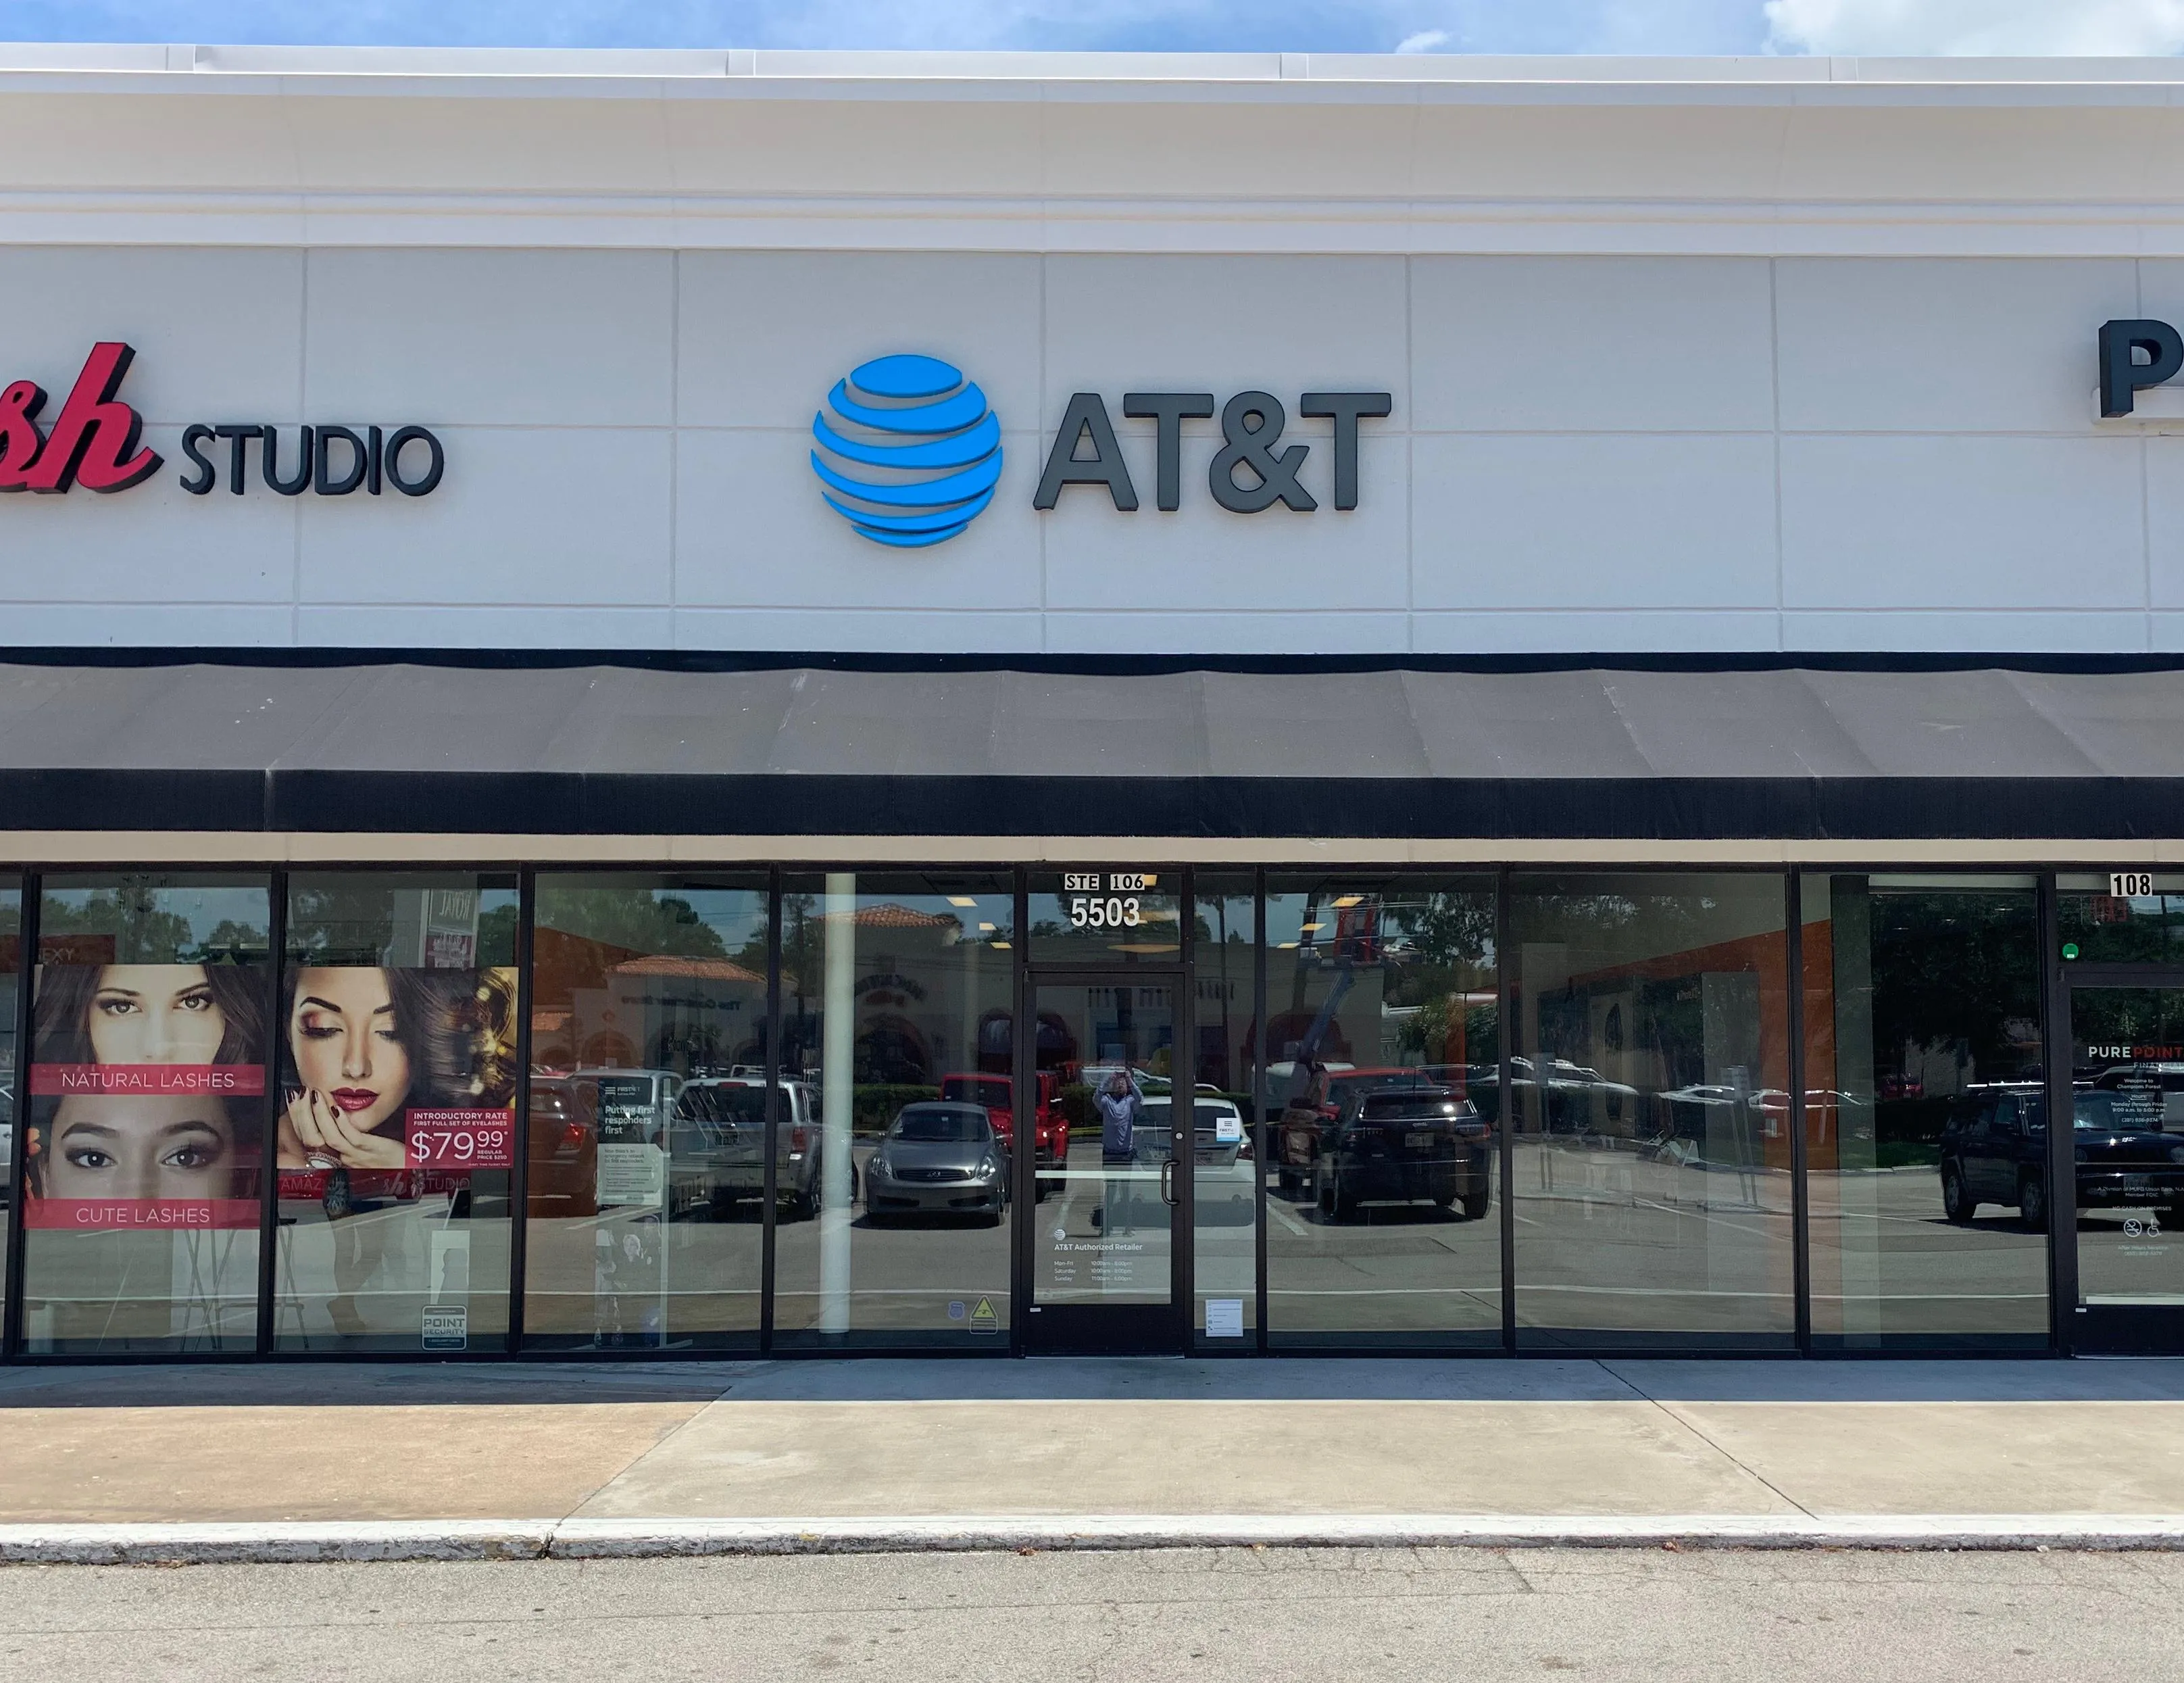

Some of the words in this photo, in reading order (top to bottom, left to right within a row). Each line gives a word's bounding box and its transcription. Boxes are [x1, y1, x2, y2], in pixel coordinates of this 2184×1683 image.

[1033, 391, 1391, 513] AT&T
[180, 424, 443, 496] STUDIO
[1066, 875, 1098, 889] STE
[1113, 875, 1143, 889] 106
[2114, 874, 2150, 896] 108
[1071, 897, 1139, 927] 5503
[62, 1073, 153, 1088] NATURAL
[160, 1073, 234, 1088] LASHES
[414, 1112, 482, 1120] INTRODUCTORY
[485, 1112, 507, 1120] RATE
[605, 1106, 636, 1115] Putting
[637, 1106, 655, 1115] first
[605, 1115, 652, 1125] responders
[605, 1125, 623, 1134] first
[76, 1208, 128, 1223] CUTE
[134, 1208, 210, 1223] LASHES
[424, 1318, 465, 1327] POINT
